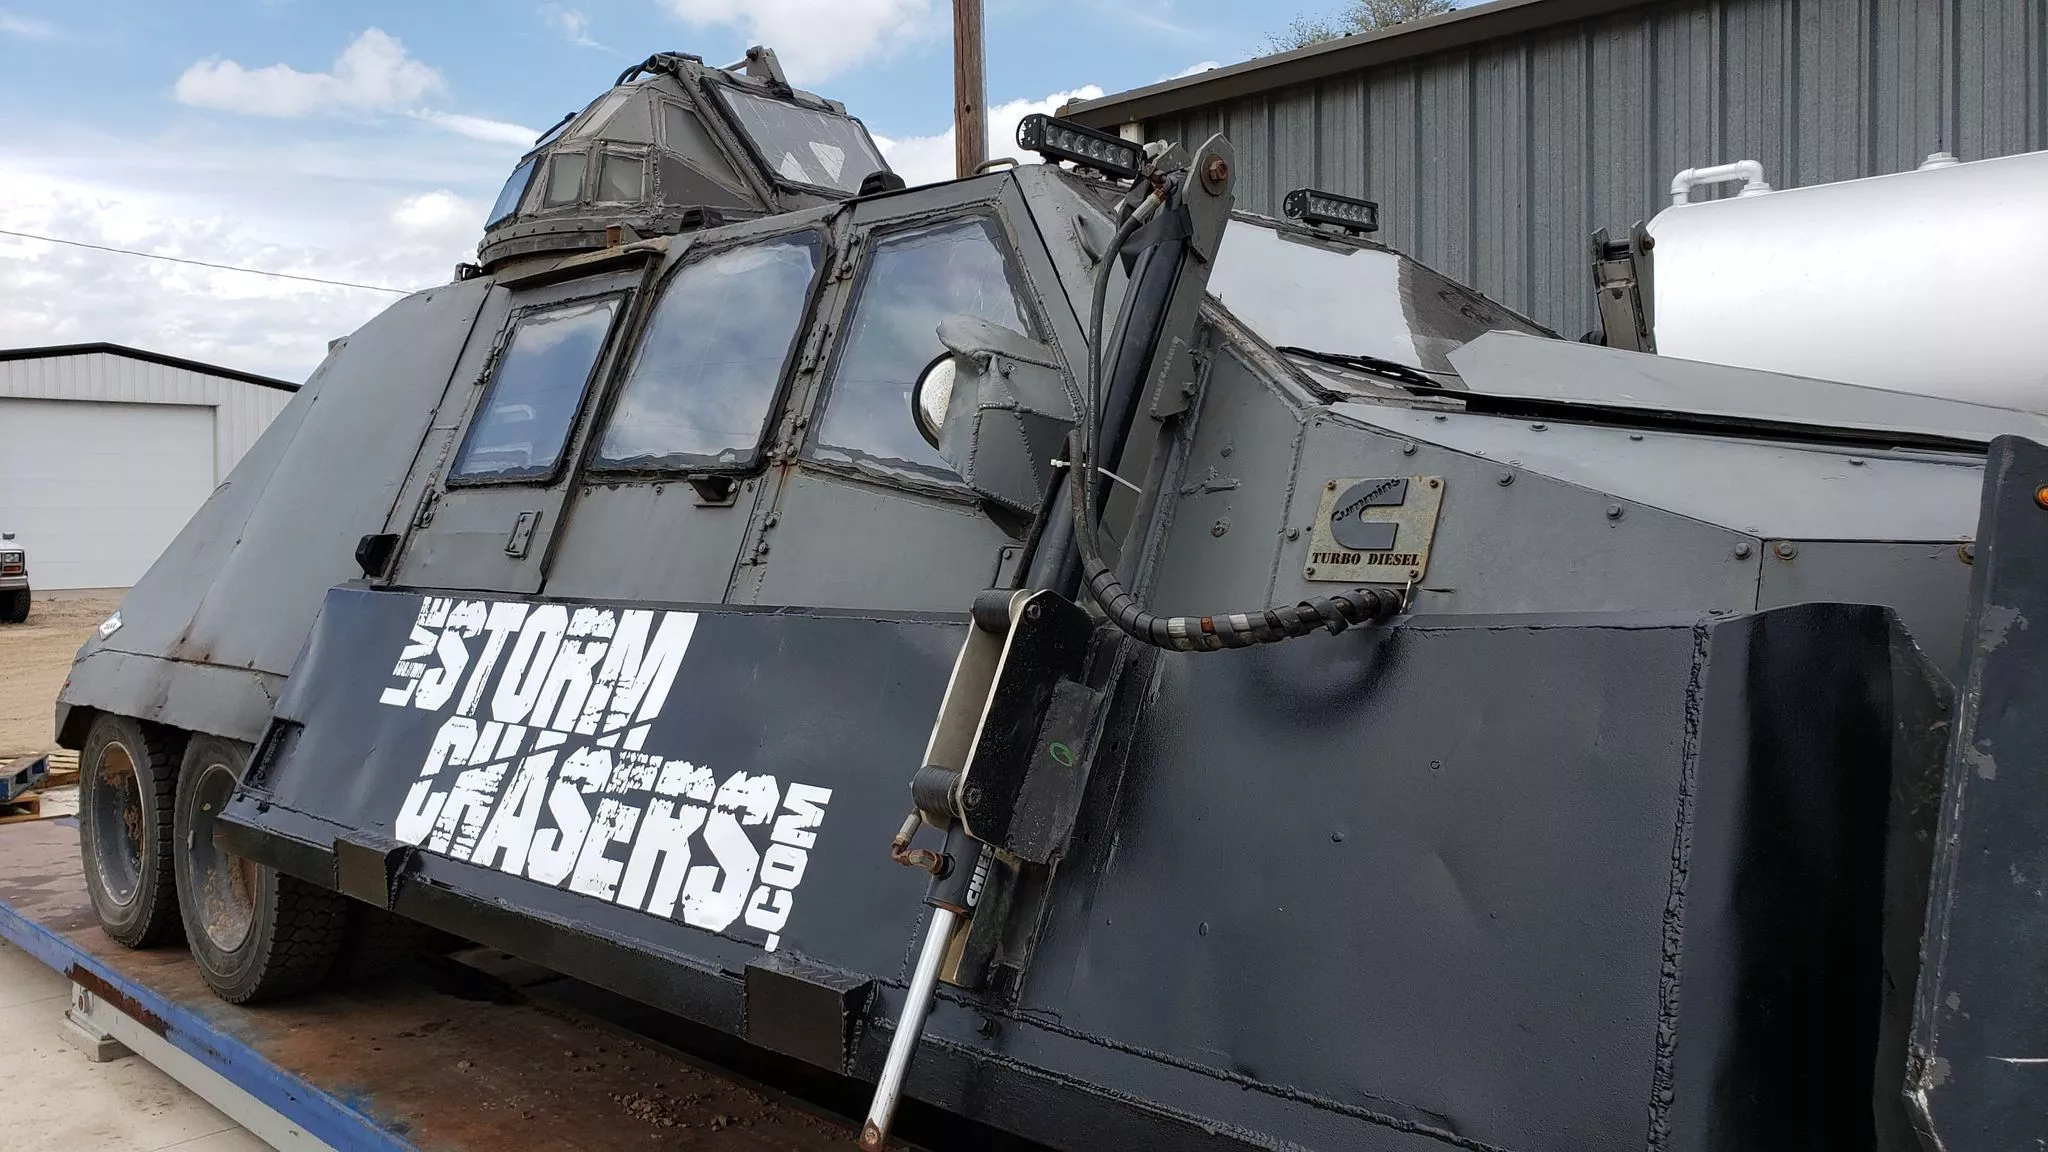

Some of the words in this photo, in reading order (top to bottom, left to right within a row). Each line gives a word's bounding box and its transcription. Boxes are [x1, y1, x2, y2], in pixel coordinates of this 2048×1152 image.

[1331, 476, 1401, 522] Cummins
[1312, 552, 1361, 565] TURBO
[1367, 553, 1420, 566] DIESEL
[379, 596, 453, 707] LIVE
[415, 599, 699, 751] STORM
[395, 715, 780, 932] CHASERS
[744, 782, 833, 952] .COM
[966, 843, 994, 907] CHIEF
